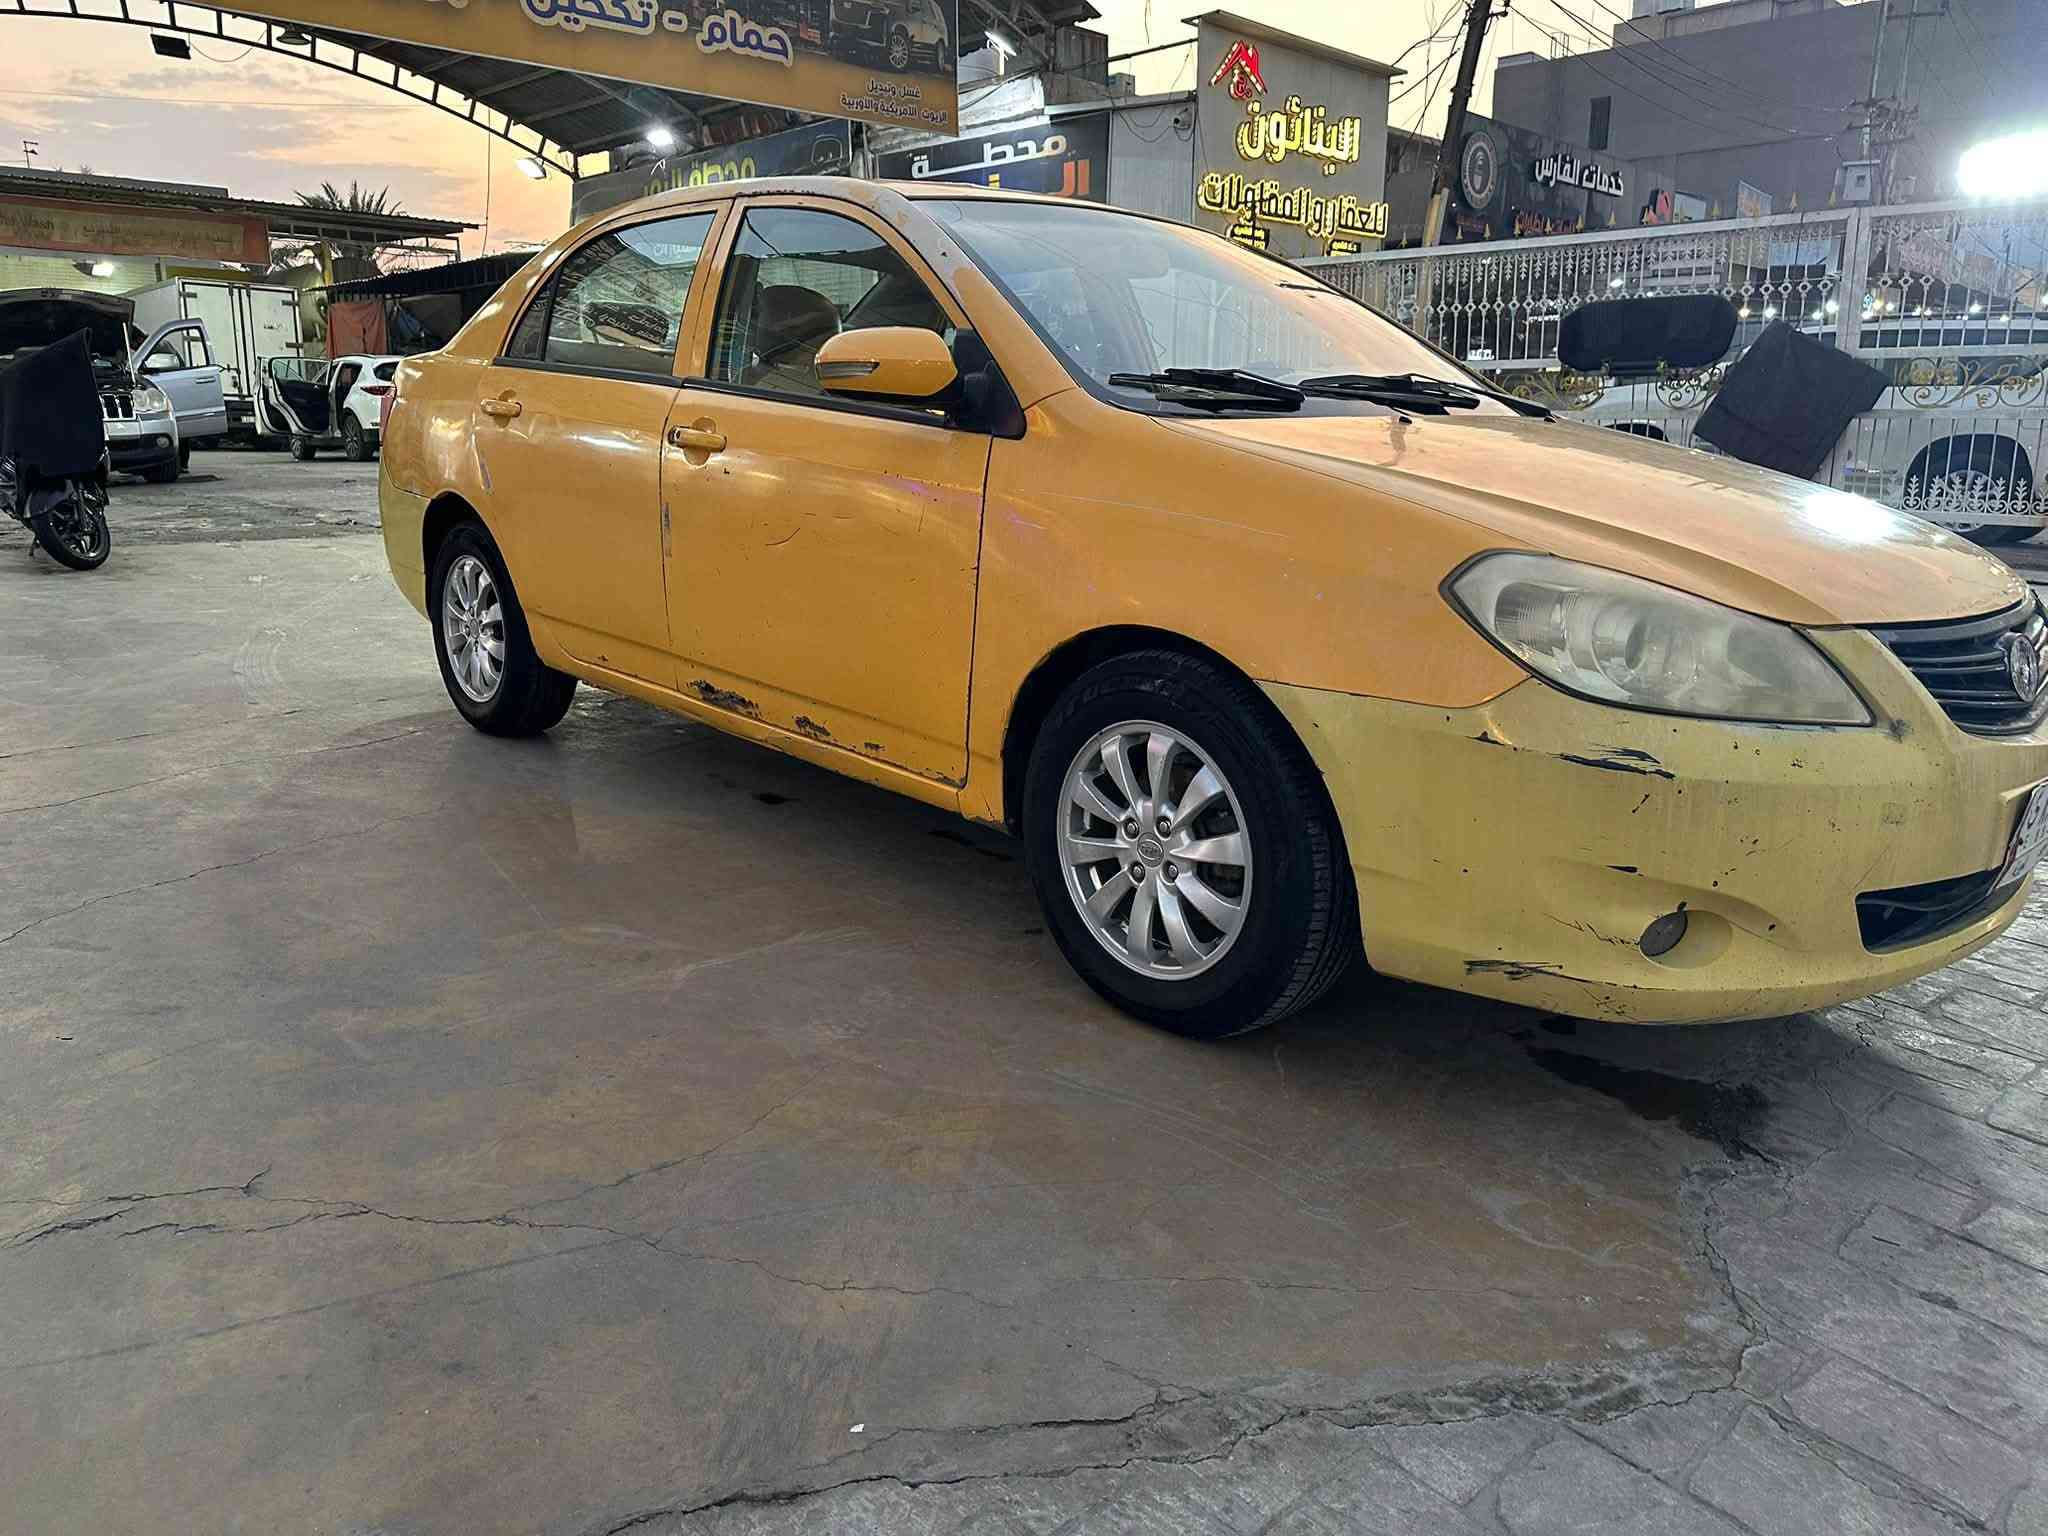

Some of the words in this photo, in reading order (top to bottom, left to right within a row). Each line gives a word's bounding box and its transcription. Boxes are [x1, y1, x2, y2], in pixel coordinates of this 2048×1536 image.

[698, 12, 790, 64] حمام
[865, 78, 897, 97] وتبديل
[897, 83, 921, 99] غسل
[911, 135, 1068, 180] محطة
[1535, 152, 1581, 188] الفارس
[1581, 164, 1624, 196] خدمات
